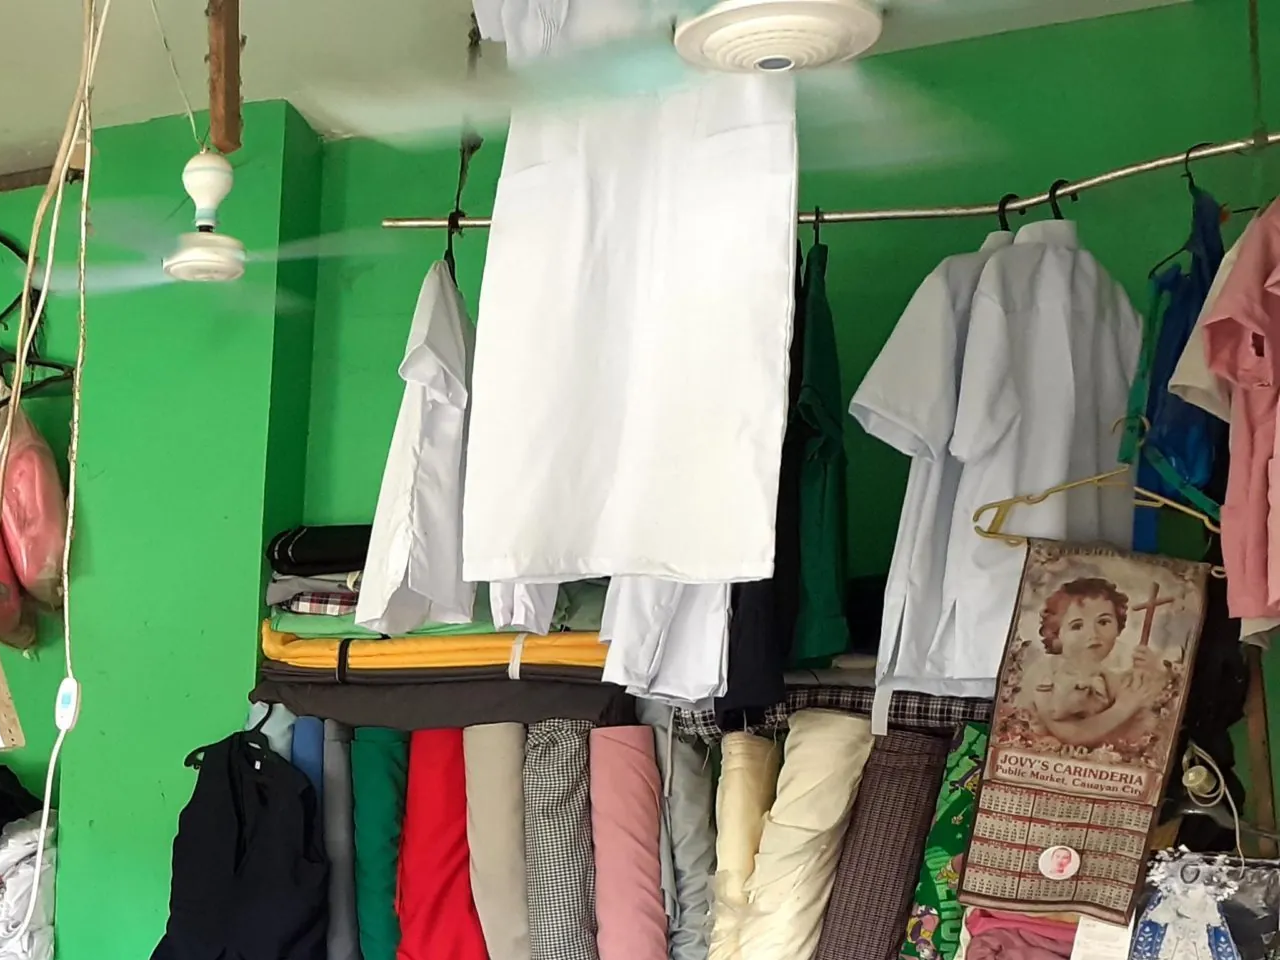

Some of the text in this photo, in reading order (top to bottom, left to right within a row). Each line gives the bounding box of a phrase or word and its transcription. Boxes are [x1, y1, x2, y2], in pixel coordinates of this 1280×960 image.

[995, 764, 1027, 778] Public
[1030, 770, 1068, 786] Market,
[1071, 778, 1119, 793] Cauayan
[1000, 753, 1144, 787] JOVY'S CARINDERIA
